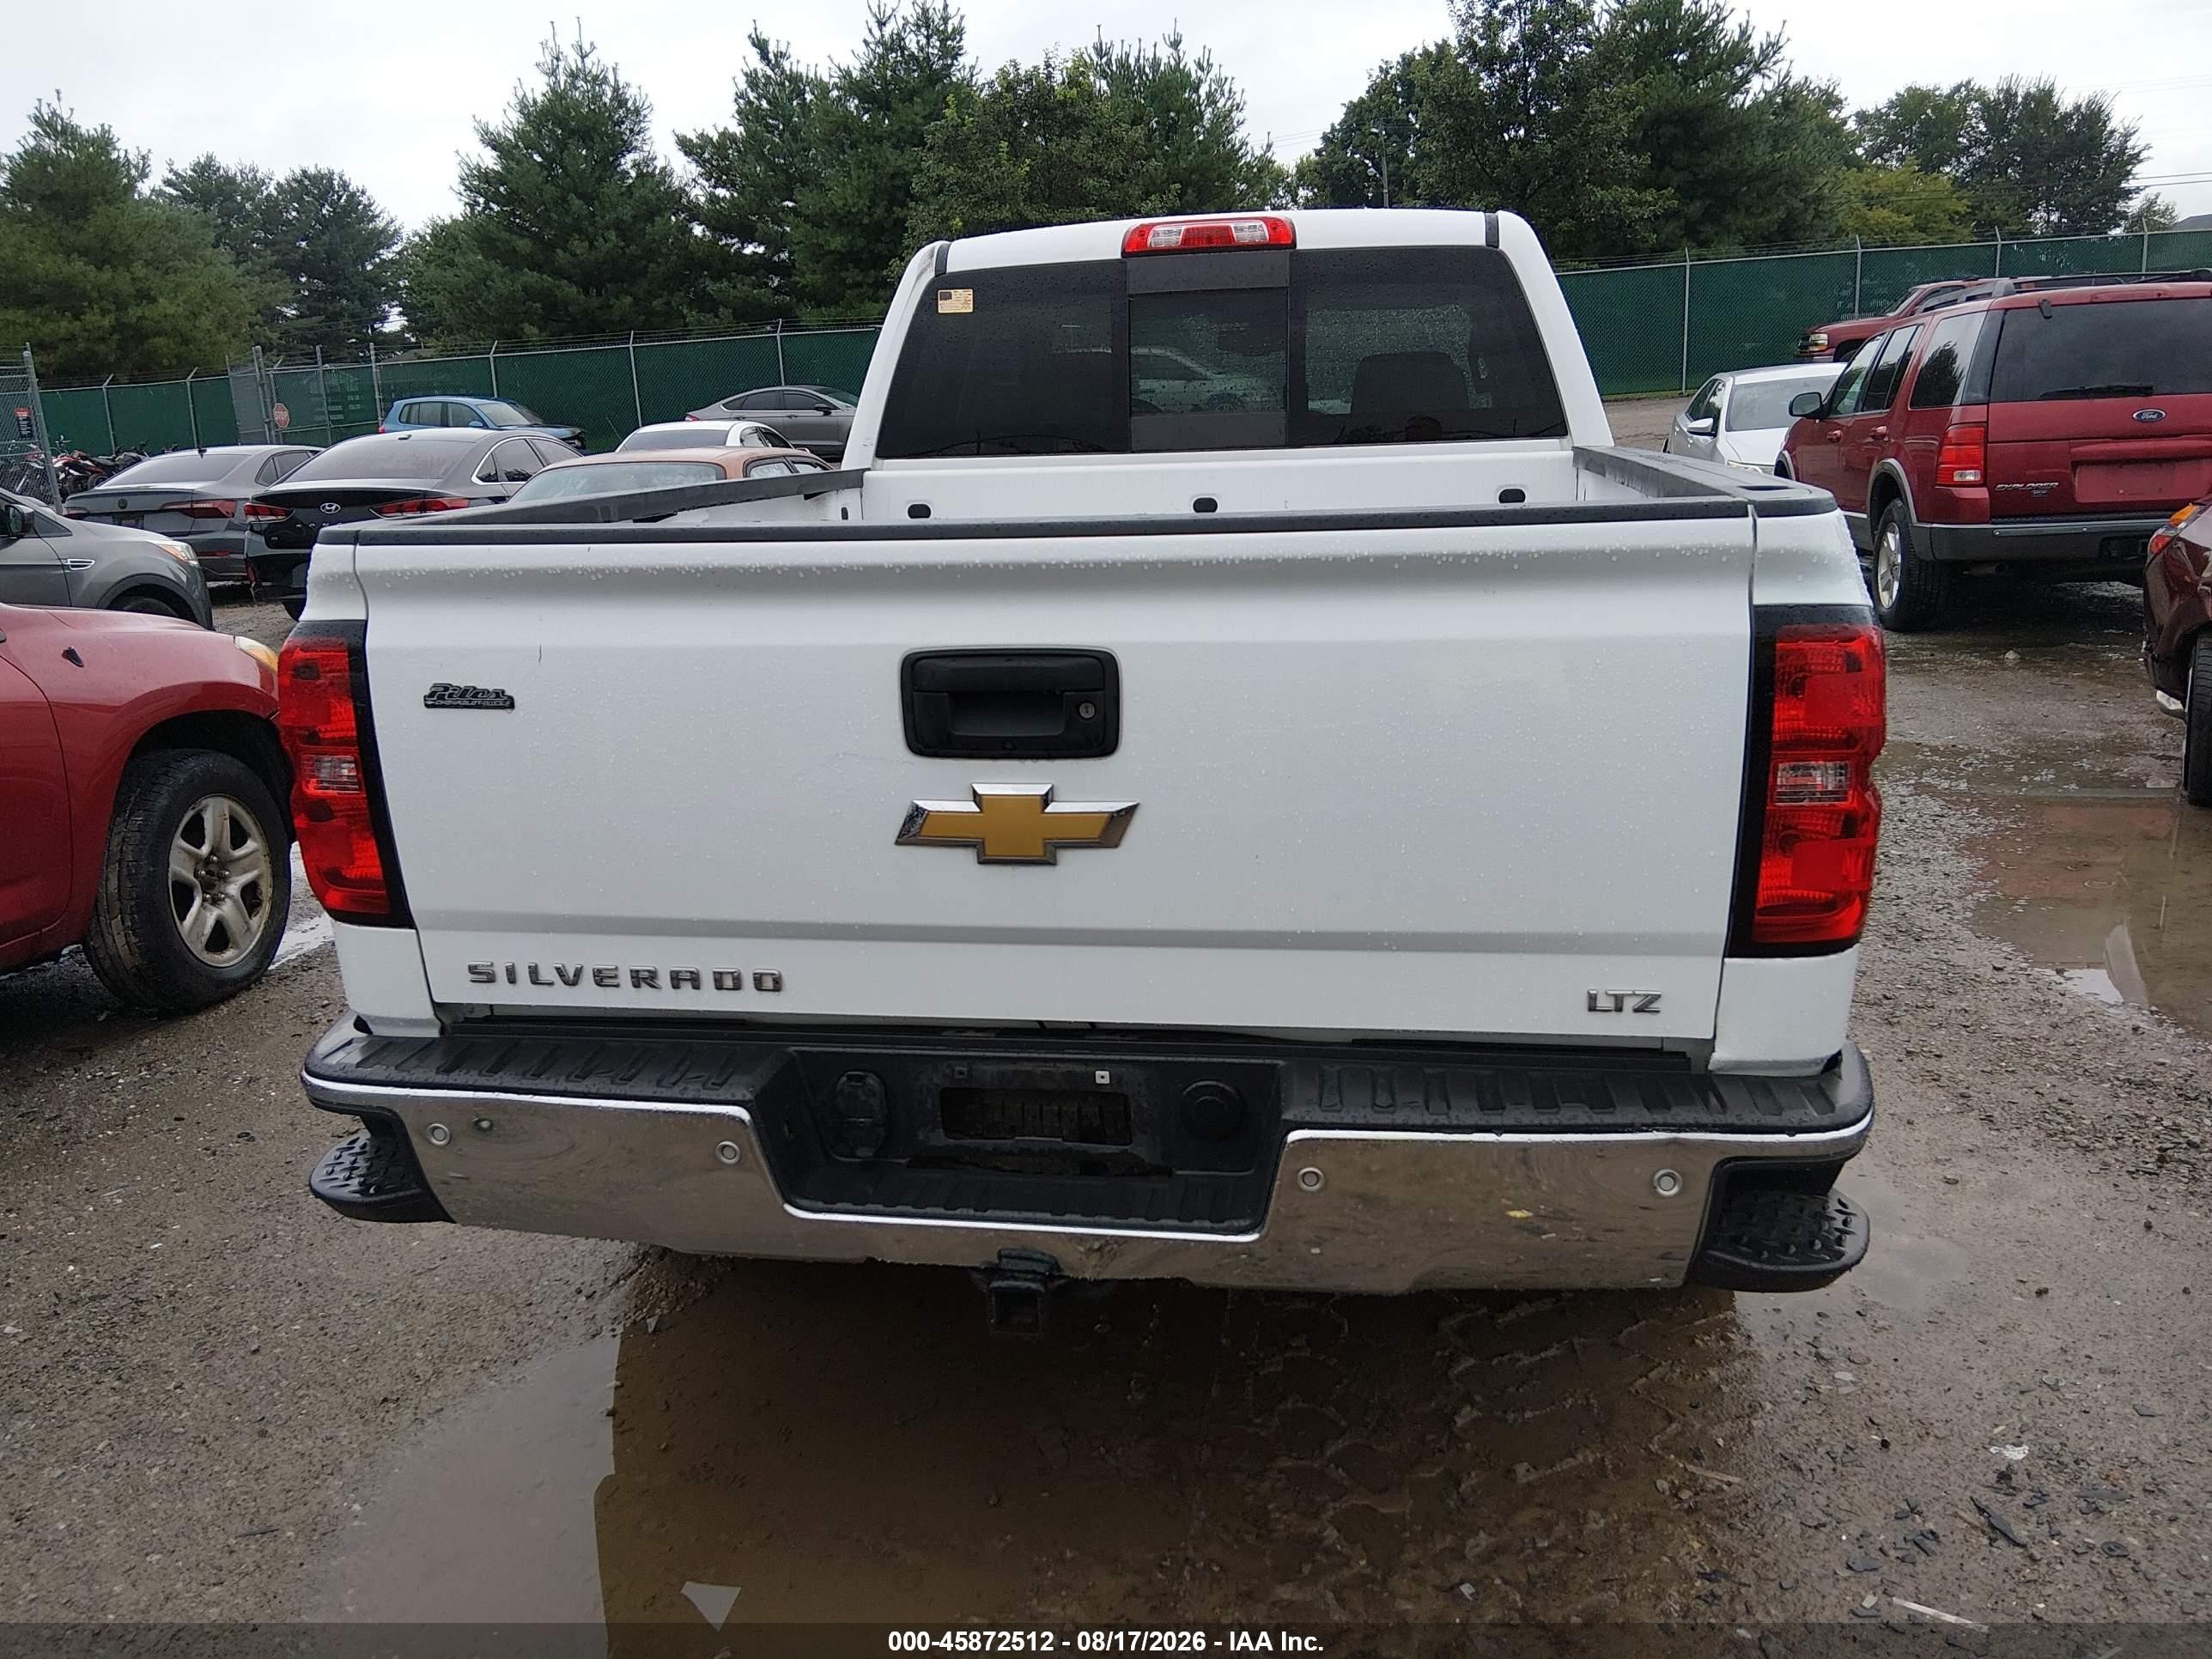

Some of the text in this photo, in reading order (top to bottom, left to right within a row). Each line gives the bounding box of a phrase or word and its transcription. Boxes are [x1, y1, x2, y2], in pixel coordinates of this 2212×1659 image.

[274, 411, 289, 420] STOP
[1995, 482, 2059, 491] EXPLORER
[467, 960, 783, 992] SILVERADO
[1587, 989, 1662, 1013] LTZ
